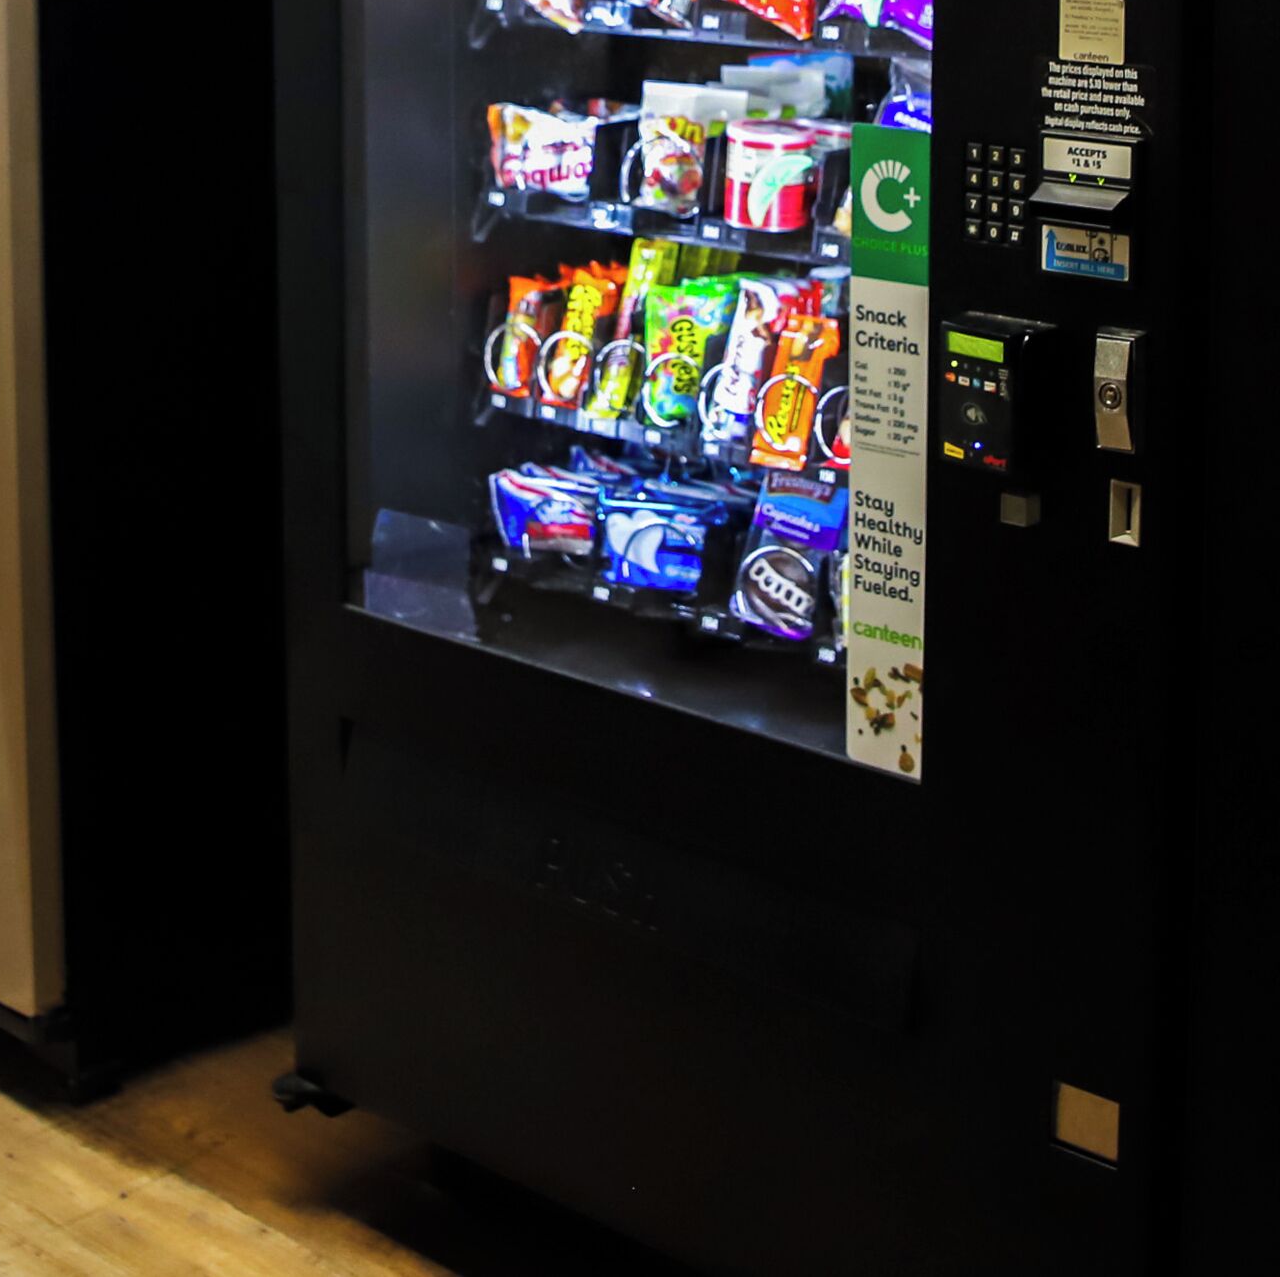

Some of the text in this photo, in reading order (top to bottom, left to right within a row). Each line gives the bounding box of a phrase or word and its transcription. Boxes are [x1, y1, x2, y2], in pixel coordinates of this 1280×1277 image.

[1049, 62, 1138, 79] The prices displayed on this
[1048, 76, 1076, 87] machine
[1077, 80, 1088, 88] are
[1122, 81, 1138, 92] than
[1041, 87, 1145, 107] the retail price and are available
[1063, 103, 1080, 113] cash
[1080, 105, 1114, 117] purchases
[1067, 147, 1107, 159] ACCEPTS
[855, 304, 907, 328] Snack
[855, 330, 920, 356] Criteria
[855, 490, 894, 517] Stay
[854, 511, 923, 546] Healthy
[854, 533, 903, 558] While
[854, 553, 920, 587] Staying
[854, 575, 914, 603] Fueled.
[853, 620, 923, 651] canteen
